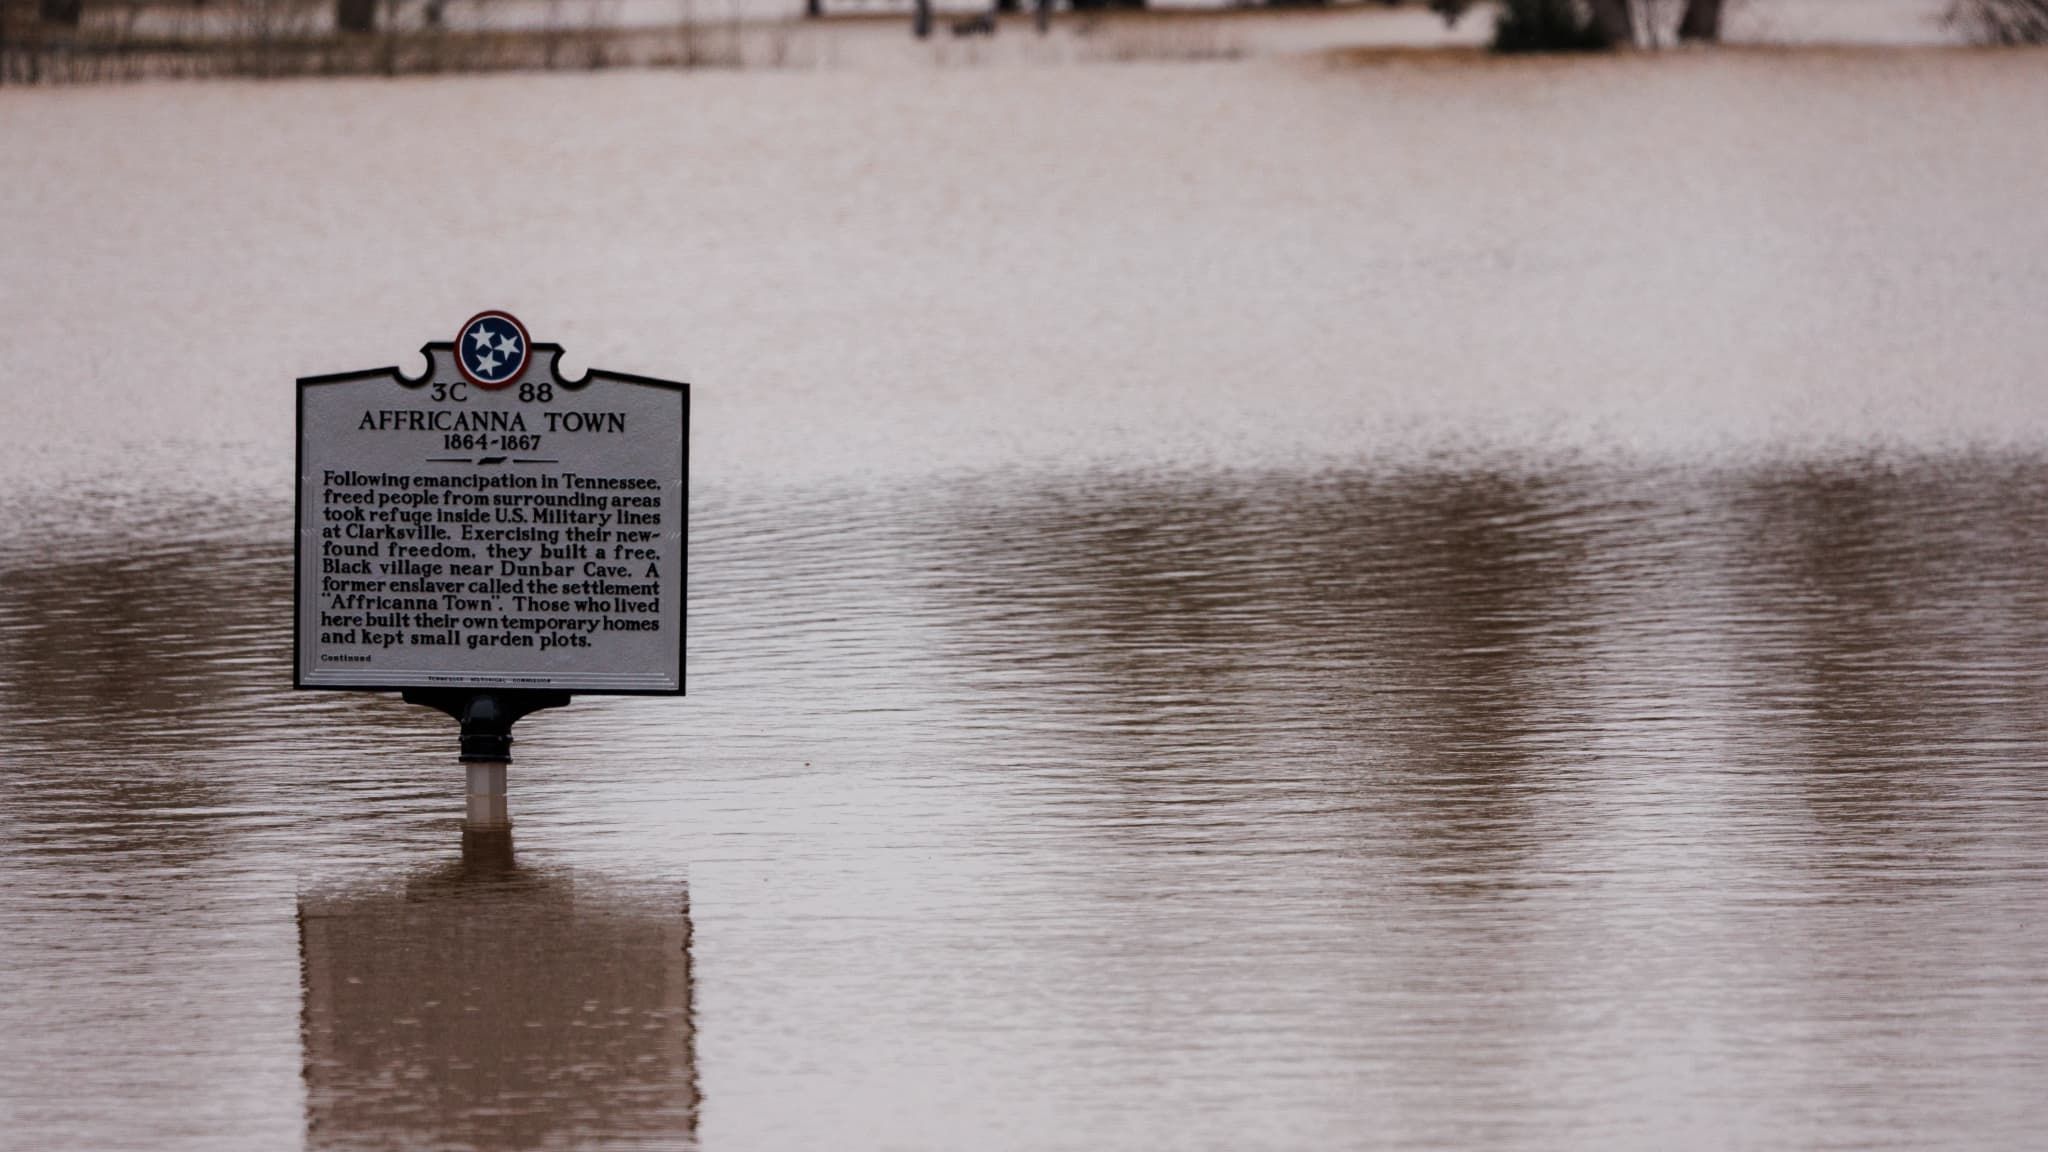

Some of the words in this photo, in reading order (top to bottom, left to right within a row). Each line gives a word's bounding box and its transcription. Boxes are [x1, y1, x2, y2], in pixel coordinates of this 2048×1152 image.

[431, 383, 467, 402] 3C
[518, 384, 554, 402] 88
[358, 411, 526, 431] AFFRICANNA
[544, 411, 626, 433] TOWN
[444, 434, 540, 450] 1864-1867
[323, 470, 410, 491] Following
[413, 473, 537, 491] emancipation
[542, 474, 558, 489] in
[323, 488, 374, 504] freed
[379, 488, 438, 509] people
[444, 489, 489, 506] from
[494, 491, 607, 512] surrounding
[612, 496, 661, 508] areas
[323, 506, 365, 521] took
[370, 507, 432, 526] refuge
[438, 508, 490, 523] inside
[496, 507, 527, 523] U.S.
[533, 508, 612, 529] Military
[618, 509, 661, 525] lines
[323, 524, 340, 539] at
[346, 523, 450, 540] Clarksville.
[462, 524, 558, 546] Exercising
[566, 526, 611, 542] their
[616, 531, 660, 543] new-
[323, 540, 378, 557] found
[487, 543, 532, 563] they
[541, 542, 587, 559] built
[596, 548, 606, 559] a
[323, 558, 371, 574] Black
[380, 559, 442, 580] village
[450, 564, 493, 576] near
[501, 560, 574, 577] Dunbar
[584, 562, 632, 578] Cave.
[645, 562, 660, 578] A
[323, 576, 386, 592] former
[390, 575, 464, 593] enslaver
[468, 578, 524, 594] called
[527, 579, 557, 594] the
[562, 580, 660, 596] settlement
[512, 596, 569, 612] Those
[574, 597, 610, 612] who
[615, 597, 659, 613] lived
[321, 611, 362, 627] here
[366, 612, 409, 627] built
[414, 612, 459, 628] their
[463, 617, 498, 629] own
[502, 615, 600, 634] temporary
[603, 615, 659, 631] homes
[321, 628, 355, 644] and
[362, 628, 404, 648] kept
[411, 630, 460, 646] small
[467, 630, 533, 650] garden
[540, 631, 592, 650] plots.
[321, 654, 371, 663] Continued
